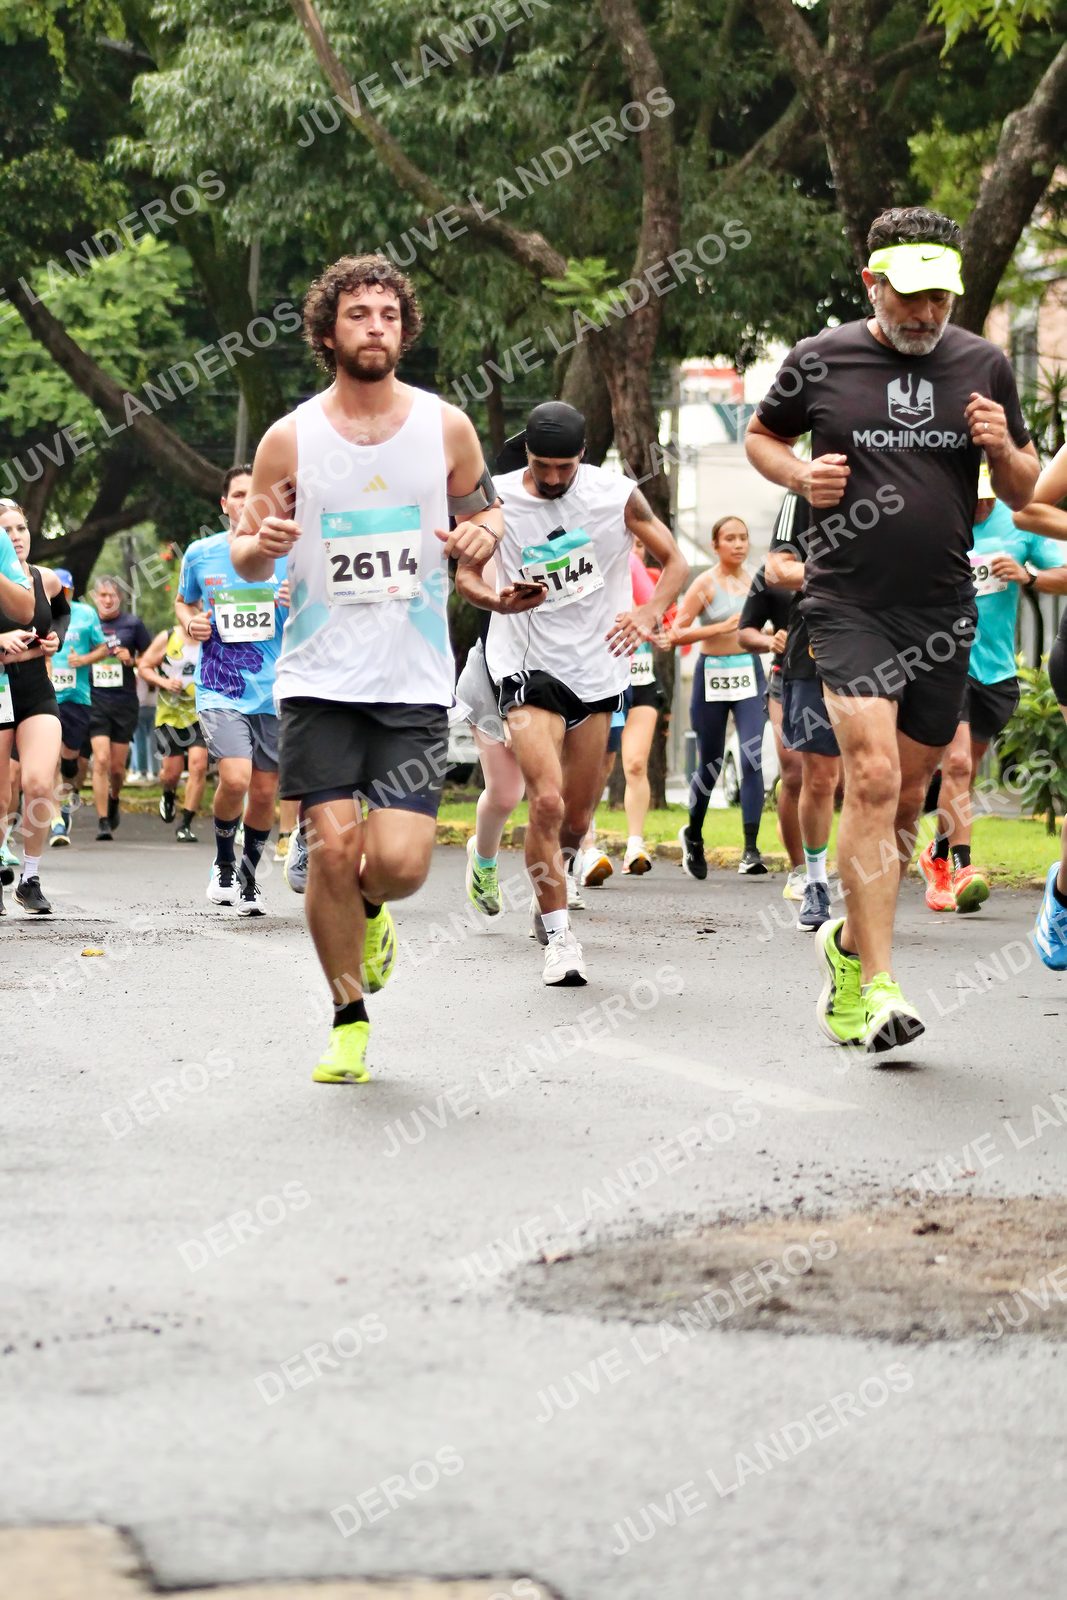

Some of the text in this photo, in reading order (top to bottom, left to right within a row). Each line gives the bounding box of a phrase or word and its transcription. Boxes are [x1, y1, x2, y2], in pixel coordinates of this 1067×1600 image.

[852, 430, 967, 449] MOHINORA
[330, 548, 418, 583] 2614
[532, 557, 593, 591] 5144
[221, 612, 271, 629] 1882
[95, 671, 120, 680] 2024
[710, 675, 750, 690] 6338
